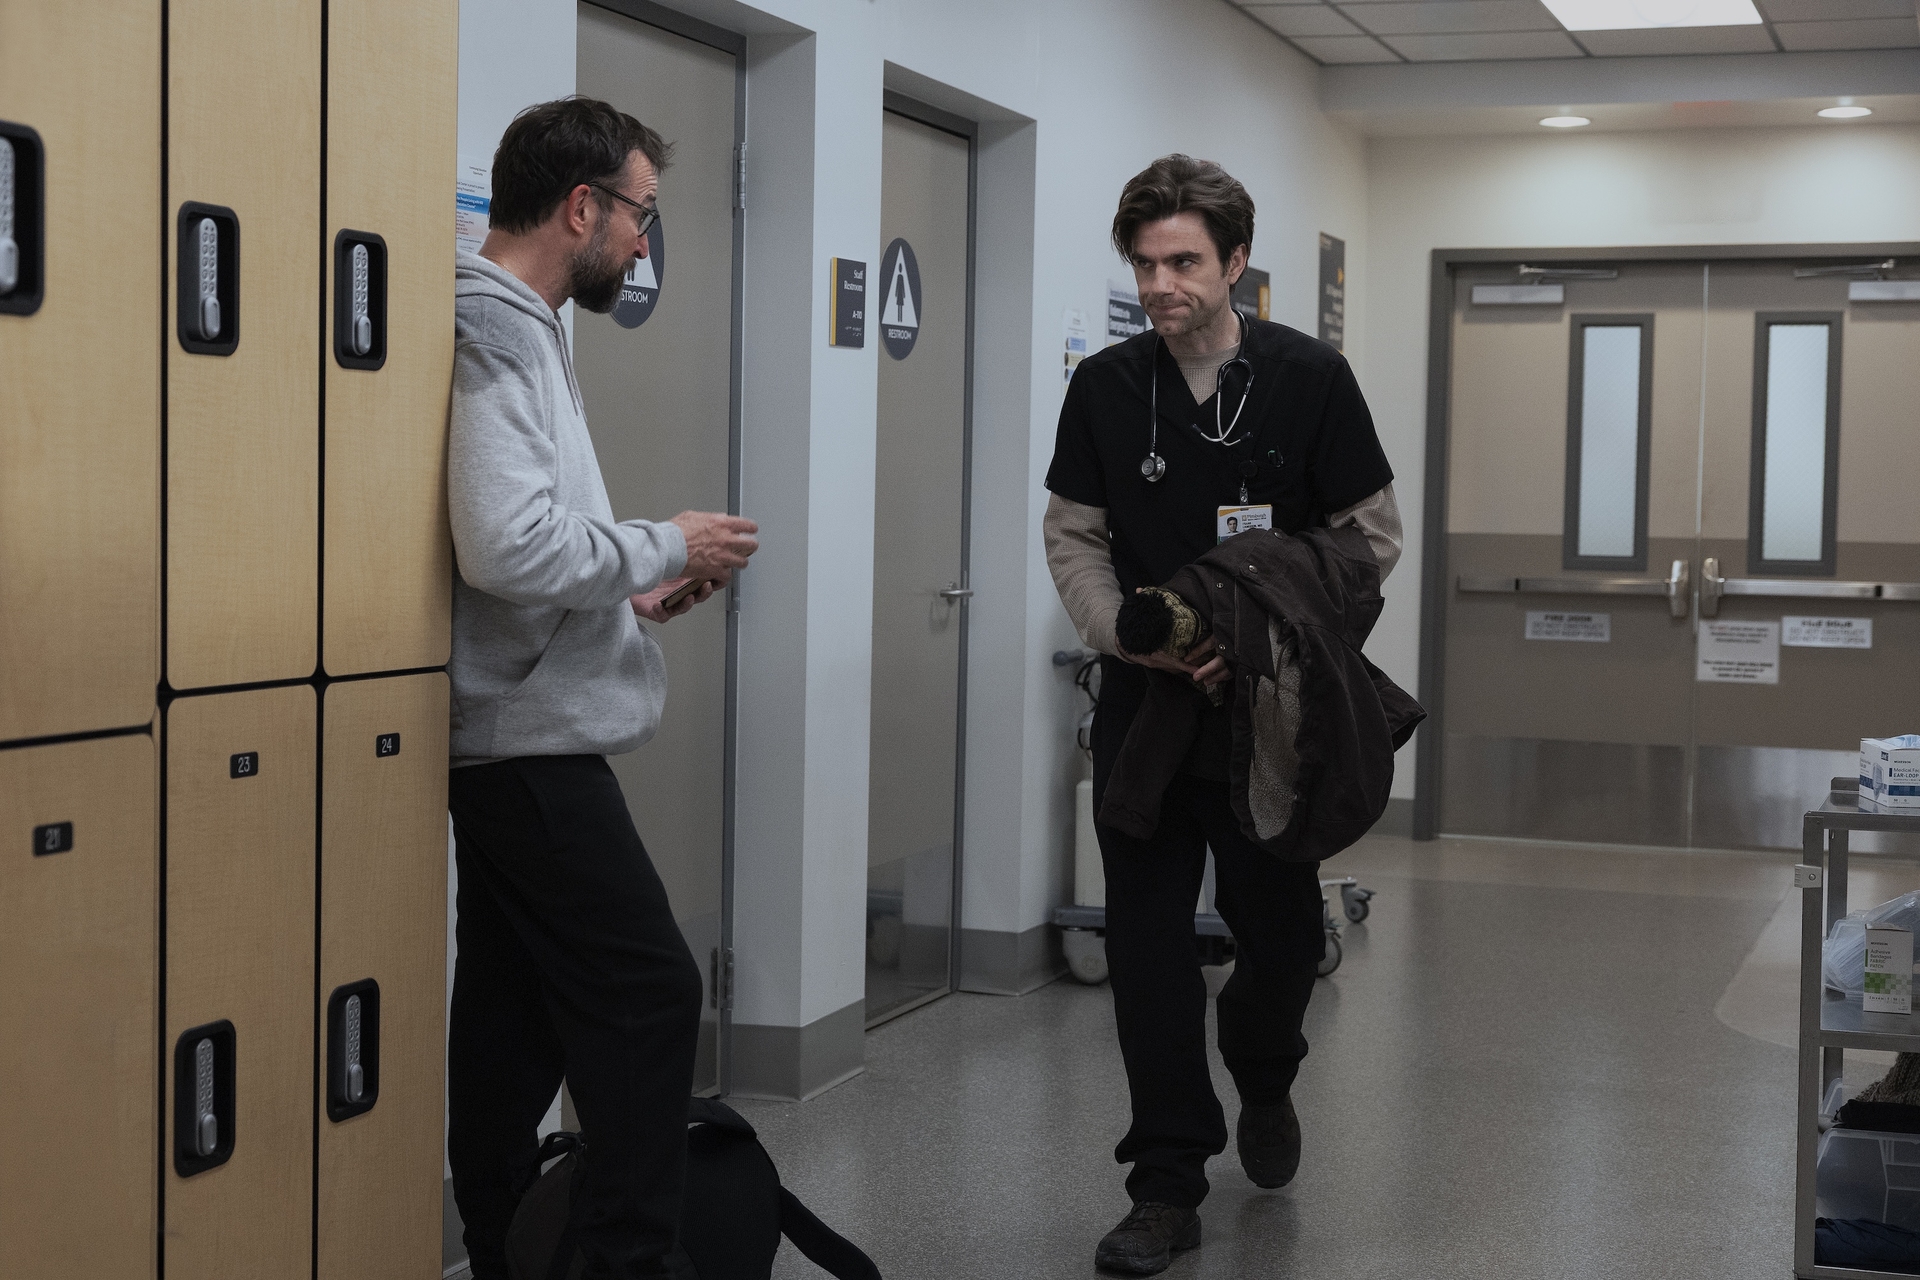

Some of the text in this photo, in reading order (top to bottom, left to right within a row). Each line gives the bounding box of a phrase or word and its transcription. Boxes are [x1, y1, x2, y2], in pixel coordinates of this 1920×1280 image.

[854, 270, 863, 279] Staff
[844, 281, 863, 292] Restroom
[621, 289, 649, 304] STROOM
[888, 329, 911, 339] RESTROOM
[381, 738, 393, 754] 24
[238, 756, 250, 773] 23
